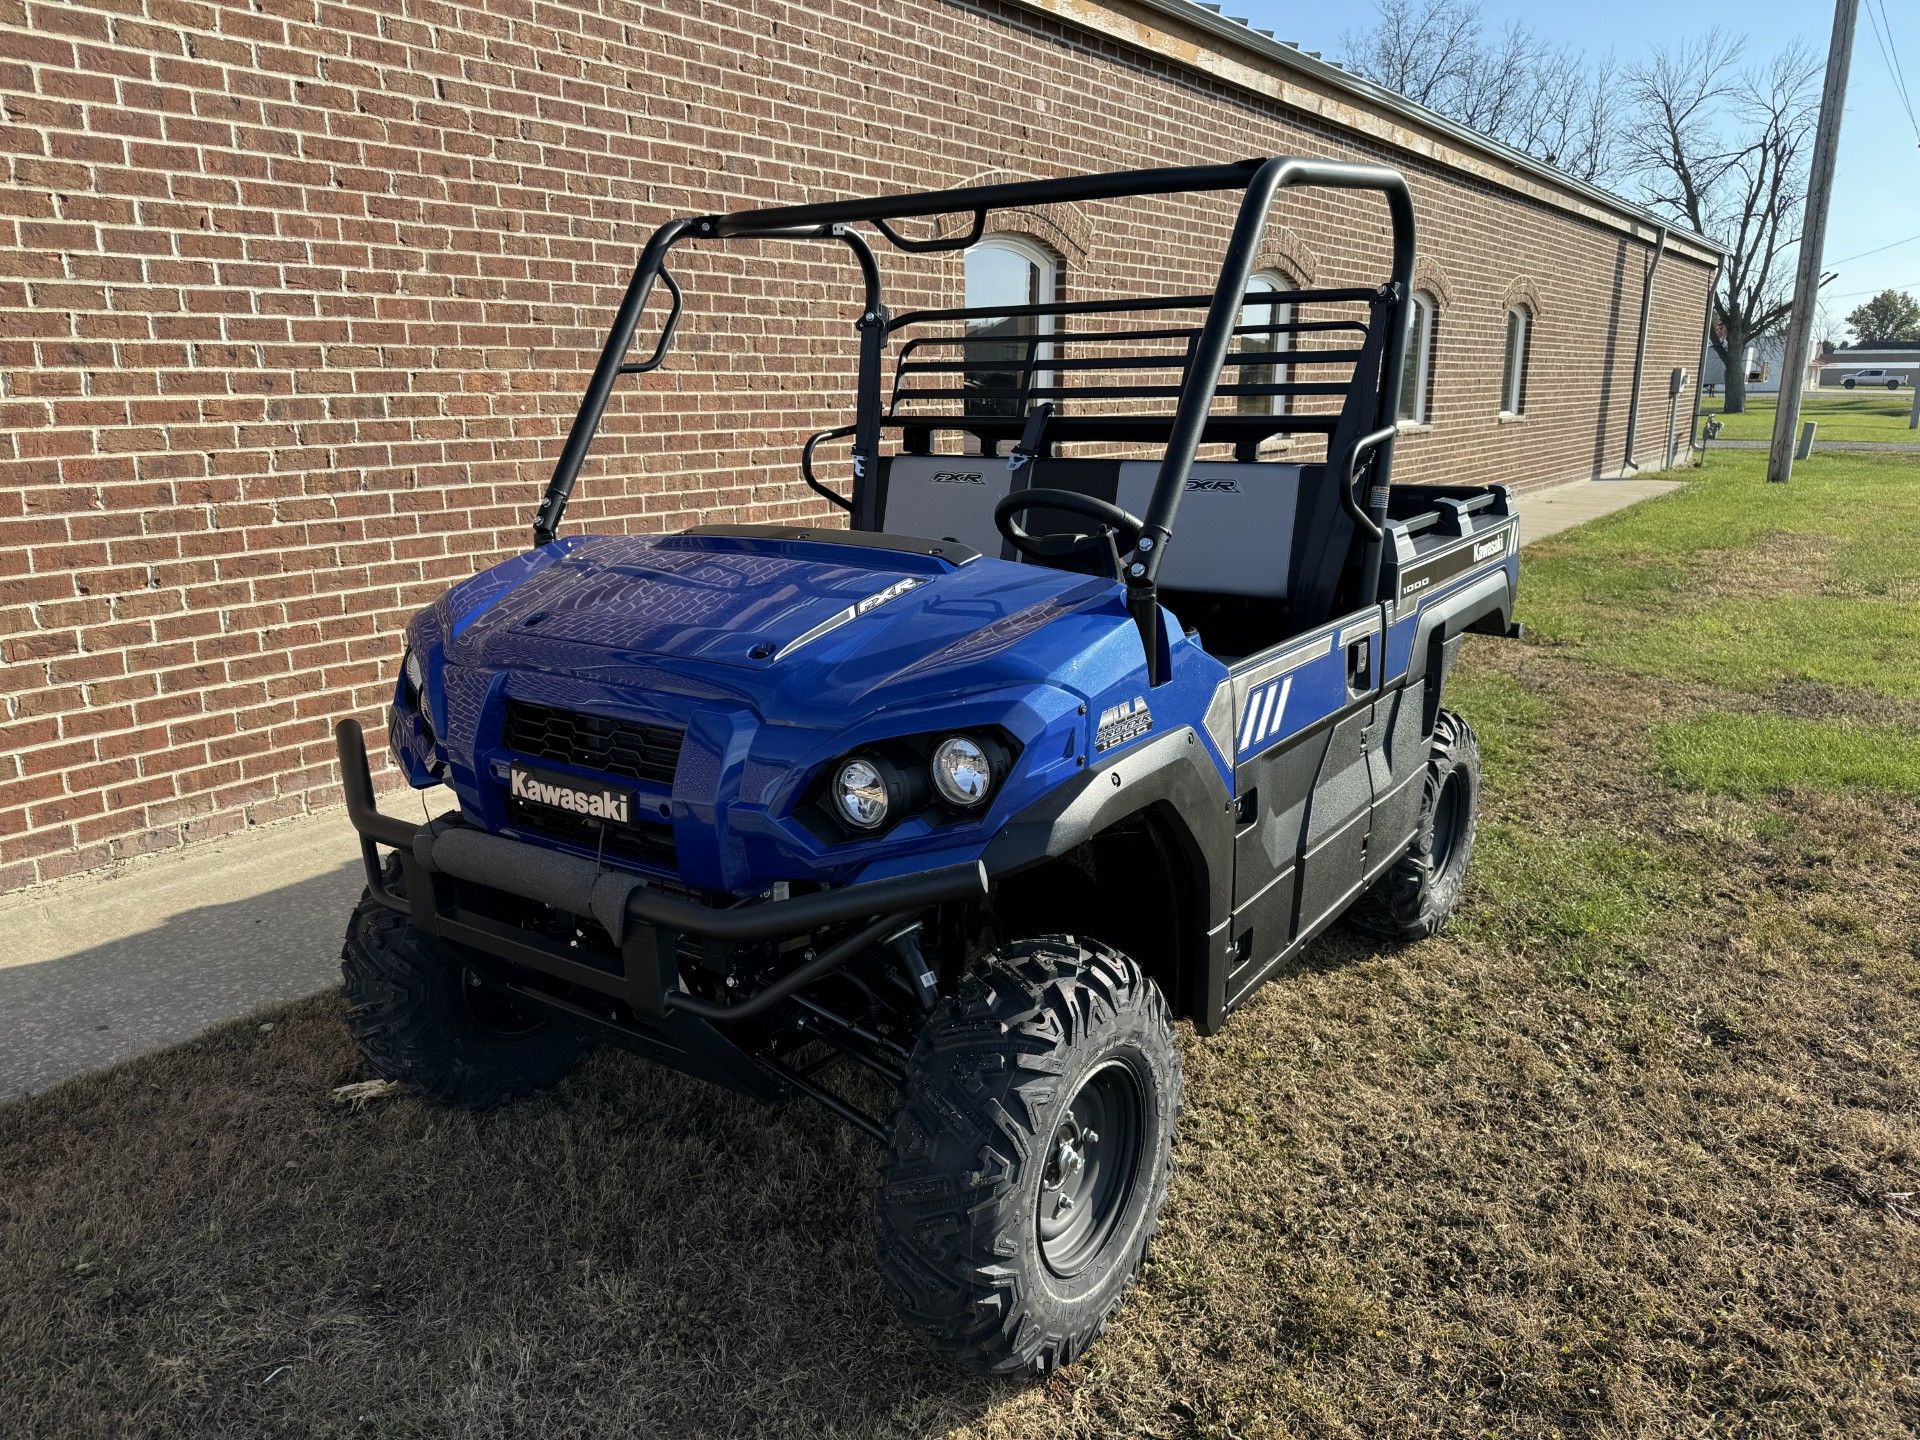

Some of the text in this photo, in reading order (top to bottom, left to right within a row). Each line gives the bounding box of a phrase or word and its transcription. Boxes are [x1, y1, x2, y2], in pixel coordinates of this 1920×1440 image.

[930, 471, 985, 484] FXR
[1184, 479, 1240, 493] XR
[1473, 533, 1504, 562] Kawasaki
[858, 578, 923, 615] FXR
[1403, 577, 1430, 595] 1000
[511, 769, 628, 823] Kawasaki
